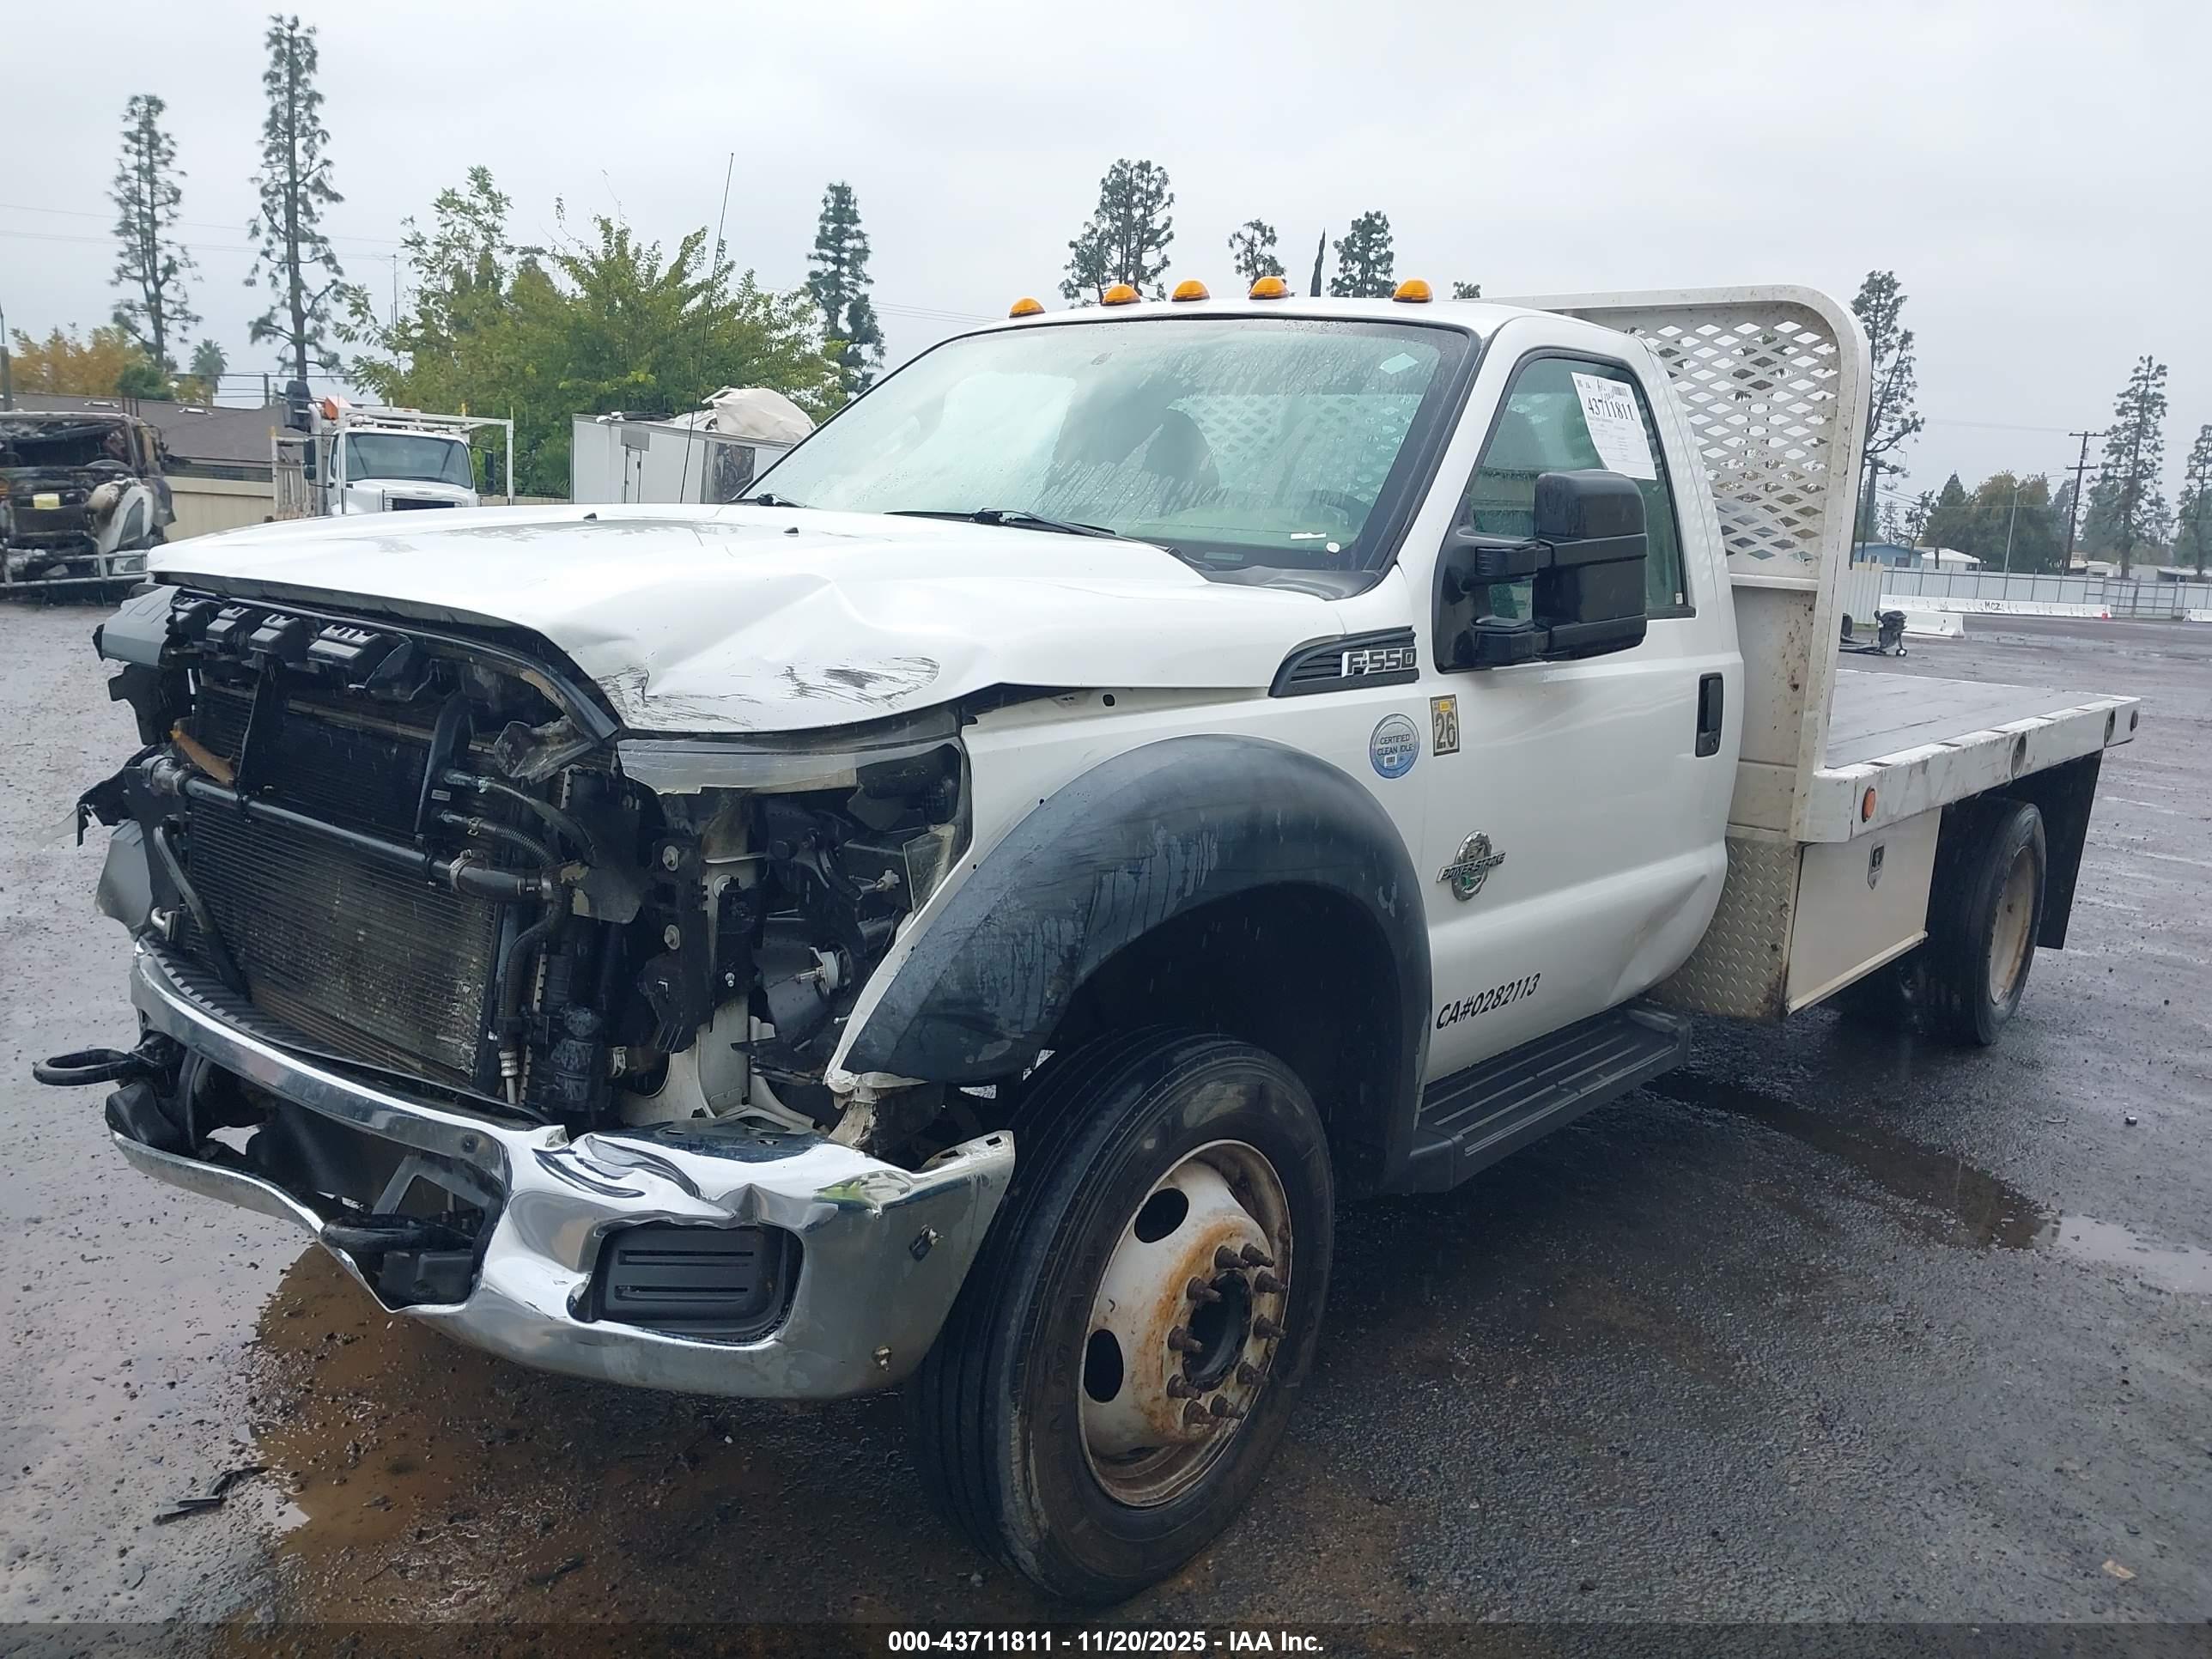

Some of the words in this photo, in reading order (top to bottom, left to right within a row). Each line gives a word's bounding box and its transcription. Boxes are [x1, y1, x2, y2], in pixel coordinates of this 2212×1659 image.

[1588, 397, 1635, 421] 43711811
[1341, 647, 1417, 678] F-550
[1379, 733, 1411, 745] CERTIFIED
[1435, 711, 1456, 750] 26
[1376, 746, 1398, 757] CLEAN
[1399, 743, 1413, 753] IDLE
[1436, 972, 1540, 1030] CA#0282113
